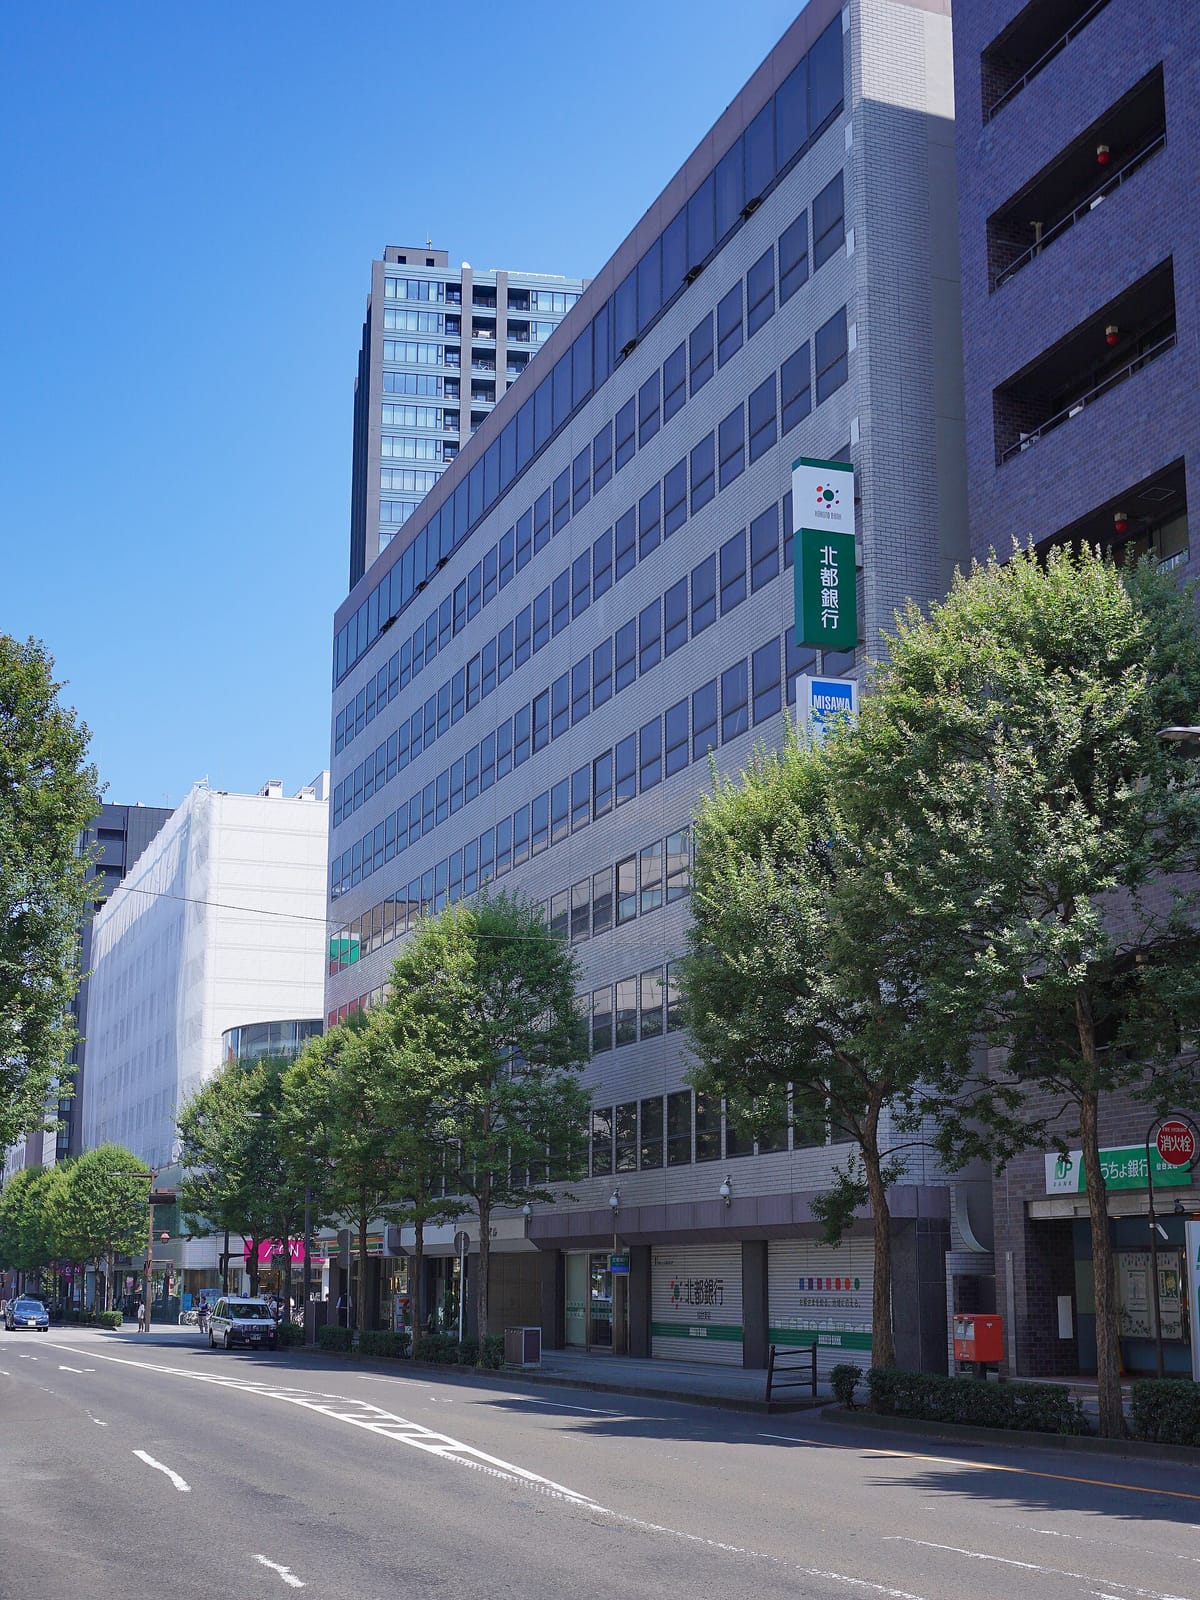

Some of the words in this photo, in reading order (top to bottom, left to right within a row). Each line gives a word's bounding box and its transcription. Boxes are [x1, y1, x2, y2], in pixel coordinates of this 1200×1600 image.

[819, 545, 840, 630] 北都銀行
[813, 695, 850, 711] MISAWA
[1160, 1135, 1192, 1152] 消火栓
[1099, 1158, 1149, 1180] うちょ銀行
[685, 1278, 724, 1306] 北都銀行
